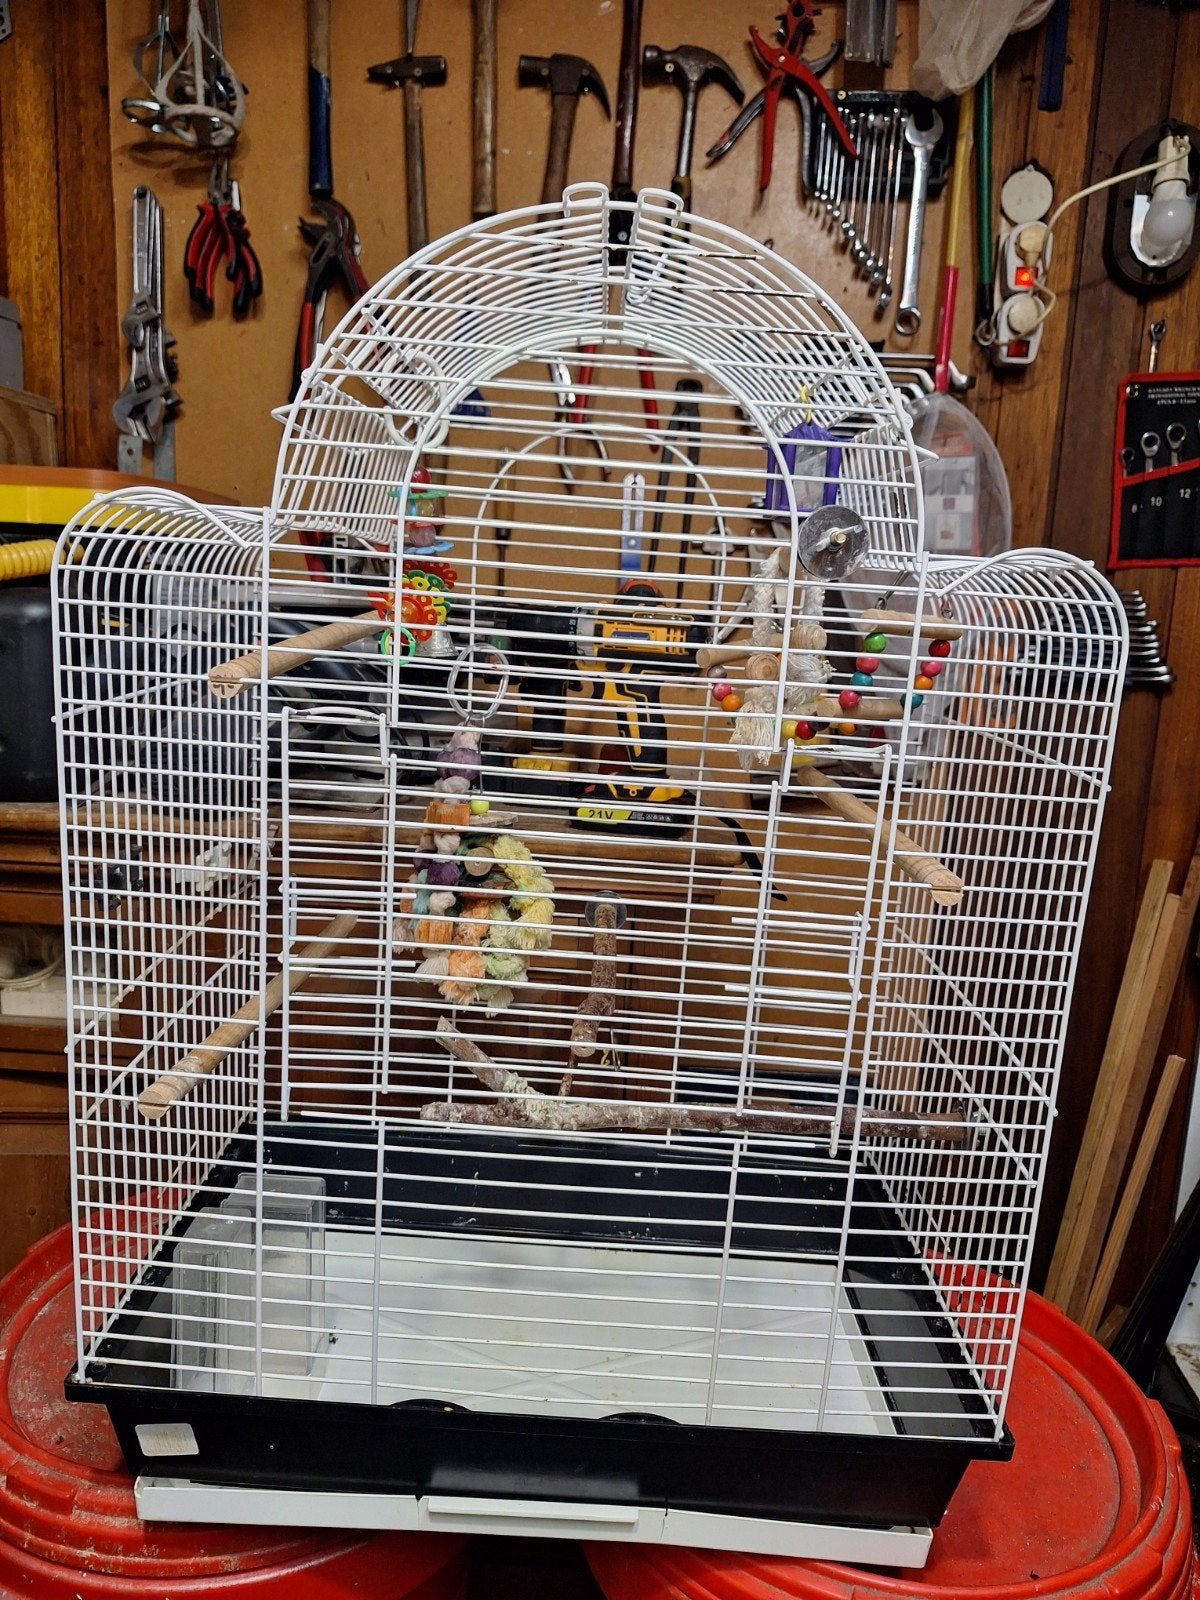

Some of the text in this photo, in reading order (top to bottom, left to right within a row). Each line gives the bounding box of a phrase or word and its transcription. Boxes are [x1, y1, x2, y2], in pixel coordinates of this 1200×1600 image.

[1150, 496, 1163, 507] 10
[1179, 488, 1191, 499] 12
[588, 809, 614, 820] 21V
